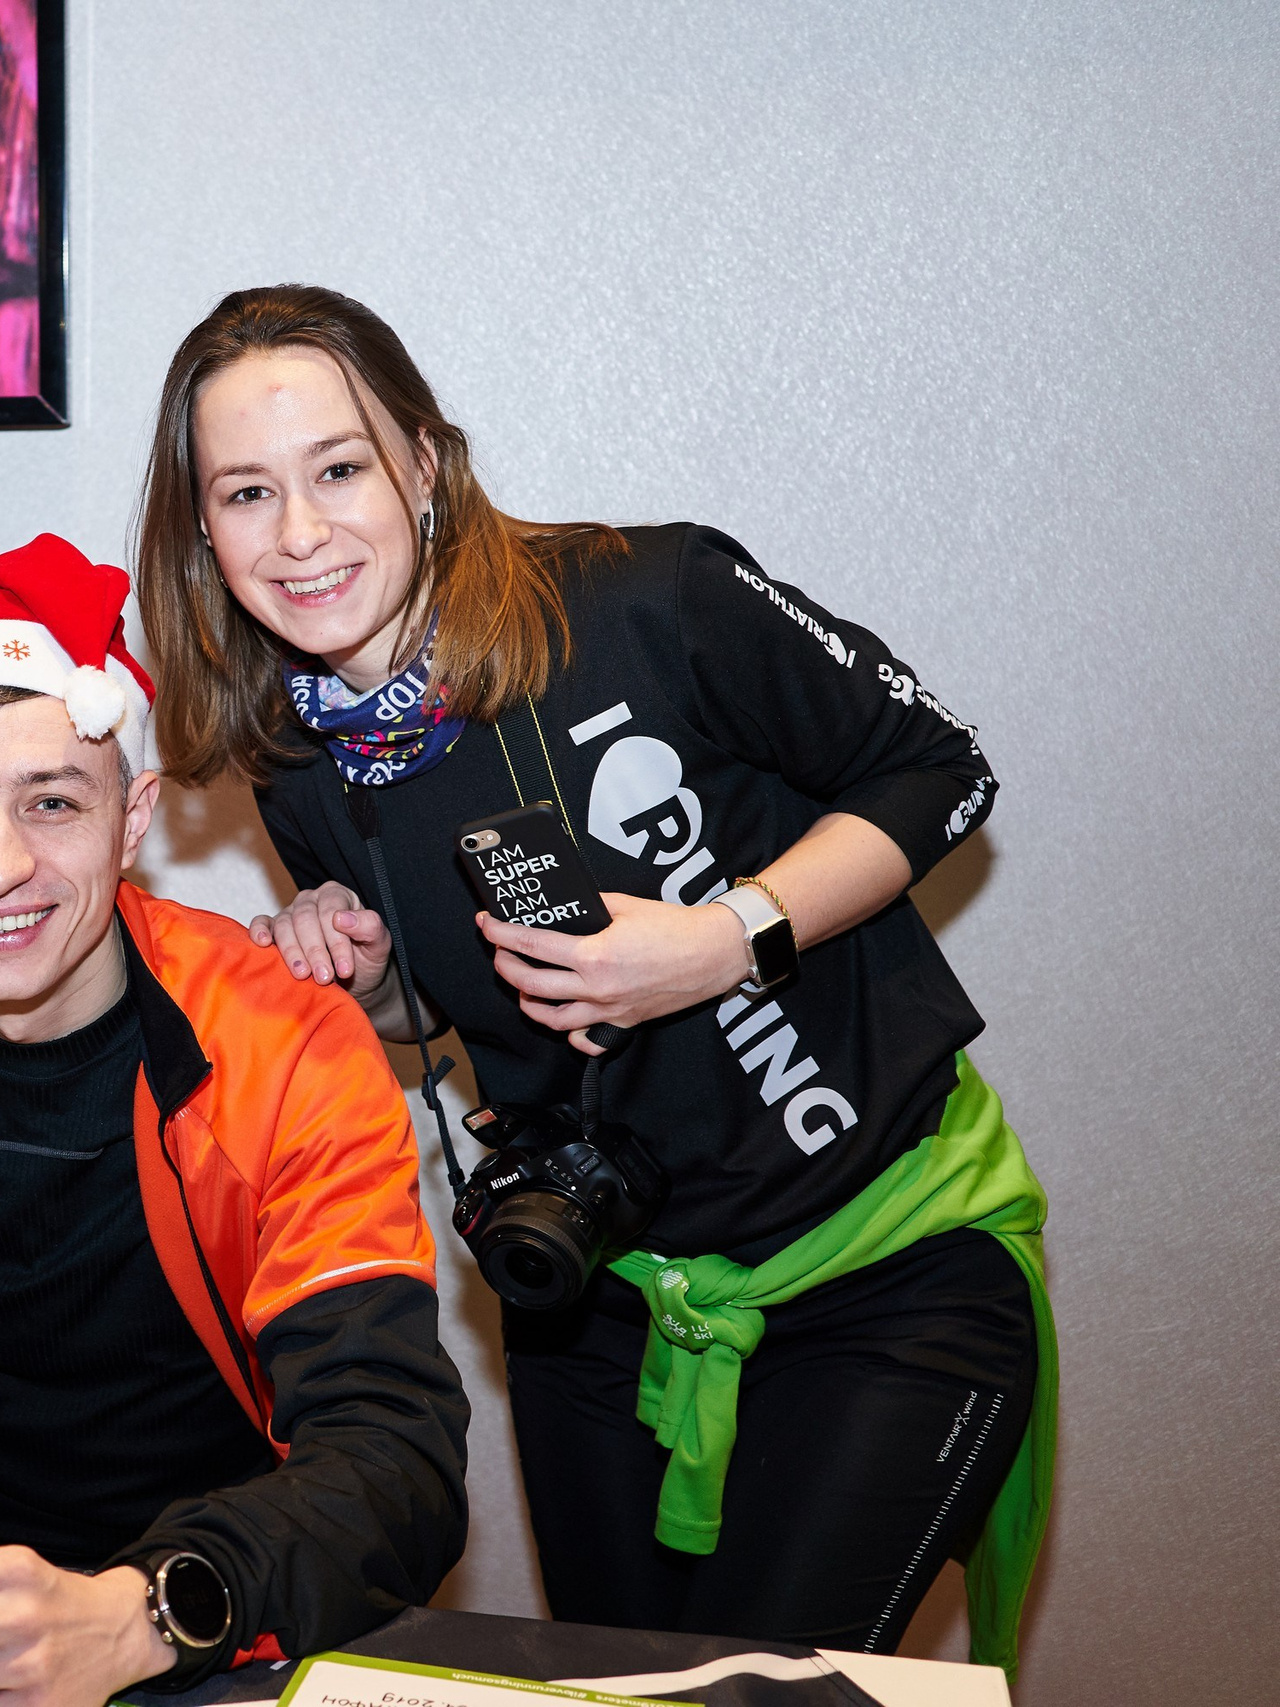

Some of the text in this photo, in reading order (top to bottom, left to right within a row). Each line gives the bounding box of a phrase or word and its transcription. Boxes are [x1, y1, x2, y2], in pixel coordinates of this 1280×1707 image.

[568, 701, 633, 746] I
[476, 843, 525, 870] I AM
[484, 853, 560, 886] SUPER
[496, 877, 541, 902] AND
[501, 892, 549, 918] I AM
[490, 1171, 520, 1190] Nikon
[935, 1423, 963, 1463] VENTAIR
[962, 1390, 978, 1414] wind
